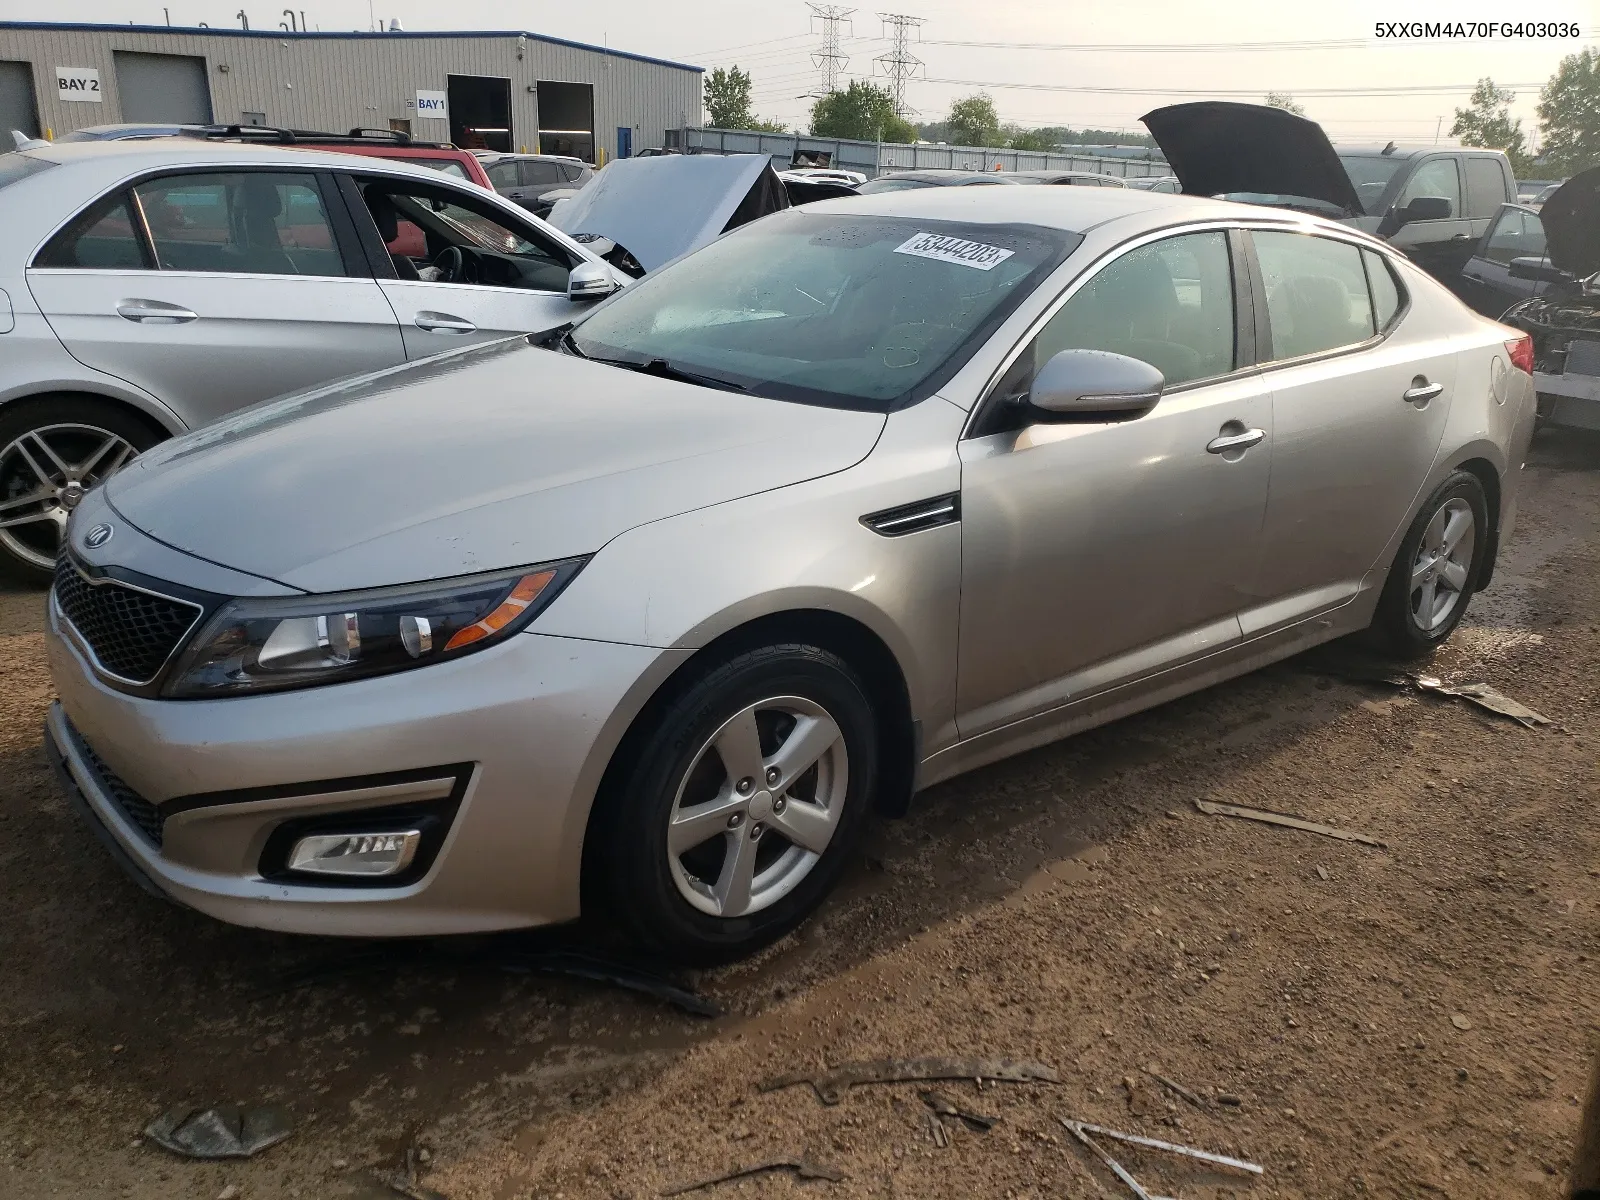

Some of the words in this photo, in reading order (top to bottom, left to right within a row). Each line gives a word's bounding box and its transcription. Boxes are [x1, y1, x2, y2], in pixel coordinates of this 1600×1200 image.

[58, 77, 87, 91] BAY
[90, 79, 100, 92] 2
[418, 98, 439, 110] BAY
[440, 100, 445, 110] 1
[914, 234, 1000, 263] 53444203
